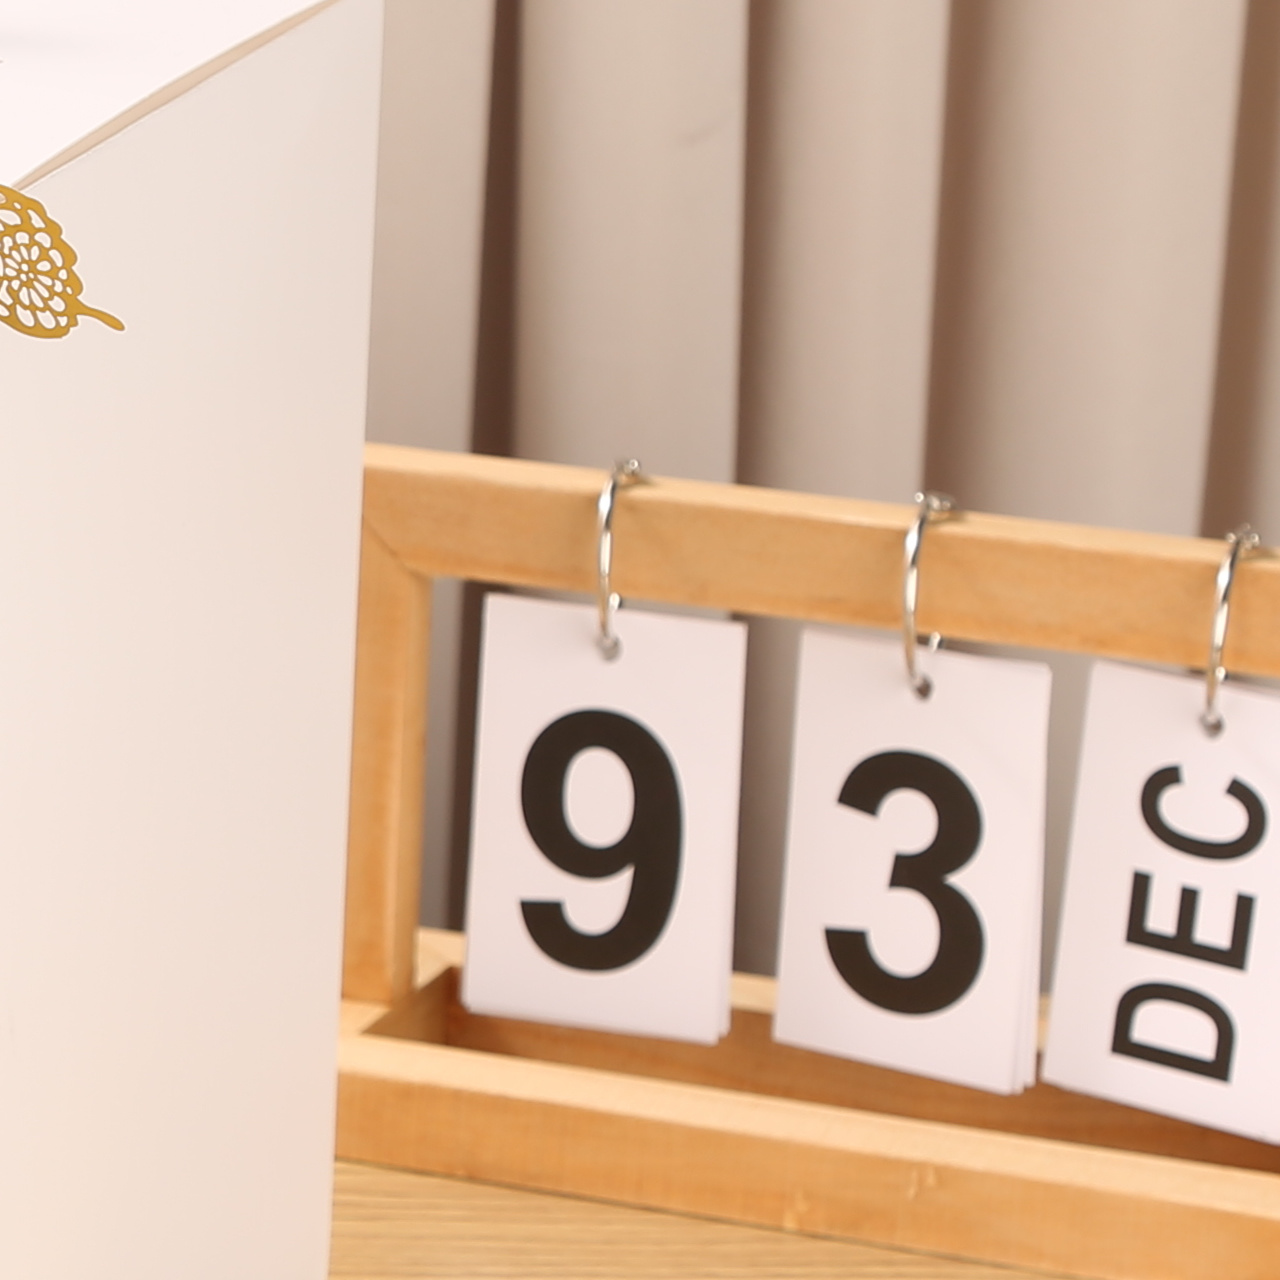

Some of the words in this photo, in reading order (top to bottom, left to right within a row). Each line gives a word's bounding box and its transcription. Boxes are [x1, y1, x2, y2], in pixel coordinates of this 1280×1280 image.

[519, 708, 684, 973] 9
[823, 749, 986, 1017] 3
[1109, 761, 1269, 1084] DEC
